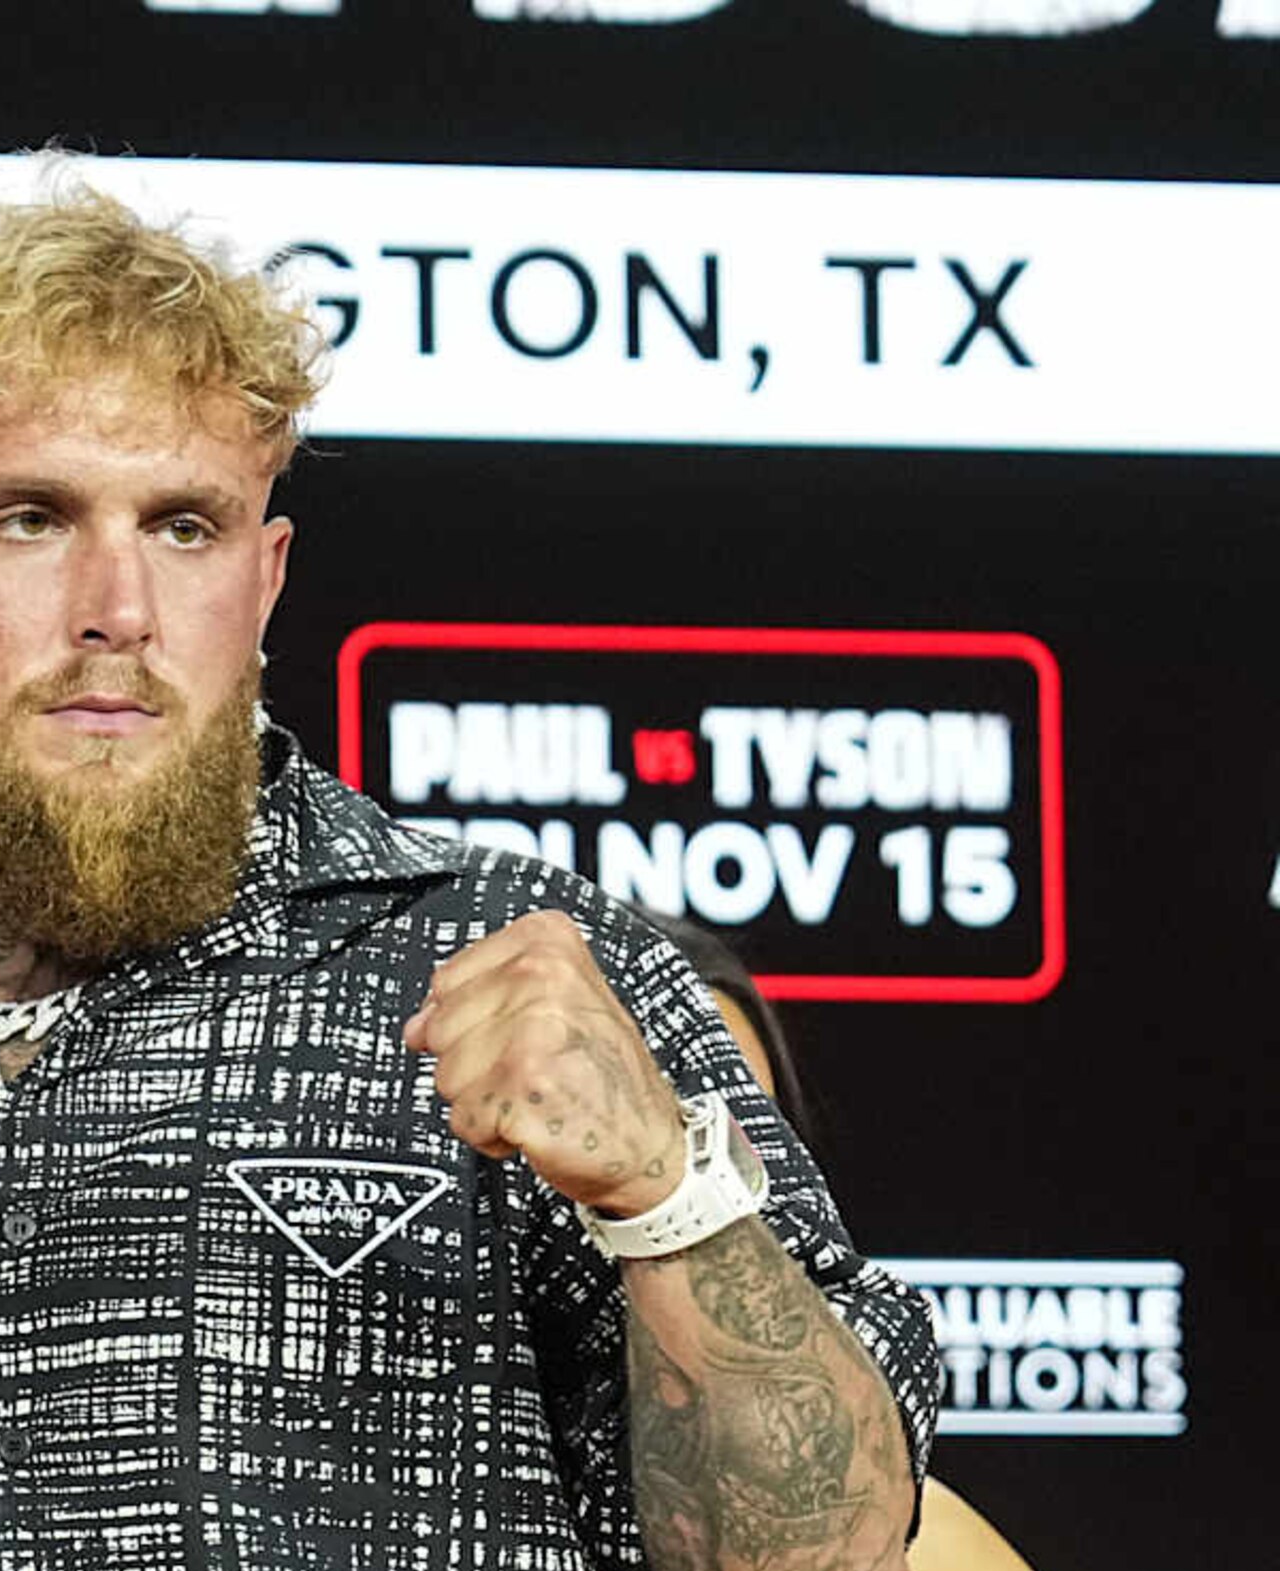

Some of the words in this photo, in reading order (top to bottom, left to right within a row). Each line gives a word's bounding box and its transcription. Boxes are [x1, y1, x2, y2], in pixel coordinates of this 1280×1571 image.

[825, 256, 1037, 368] TX
[699, 706, 1013, 811] TYSON
[878, 825, 1018, 927] 15
[270, 1176, 408, 1206] PRADA
